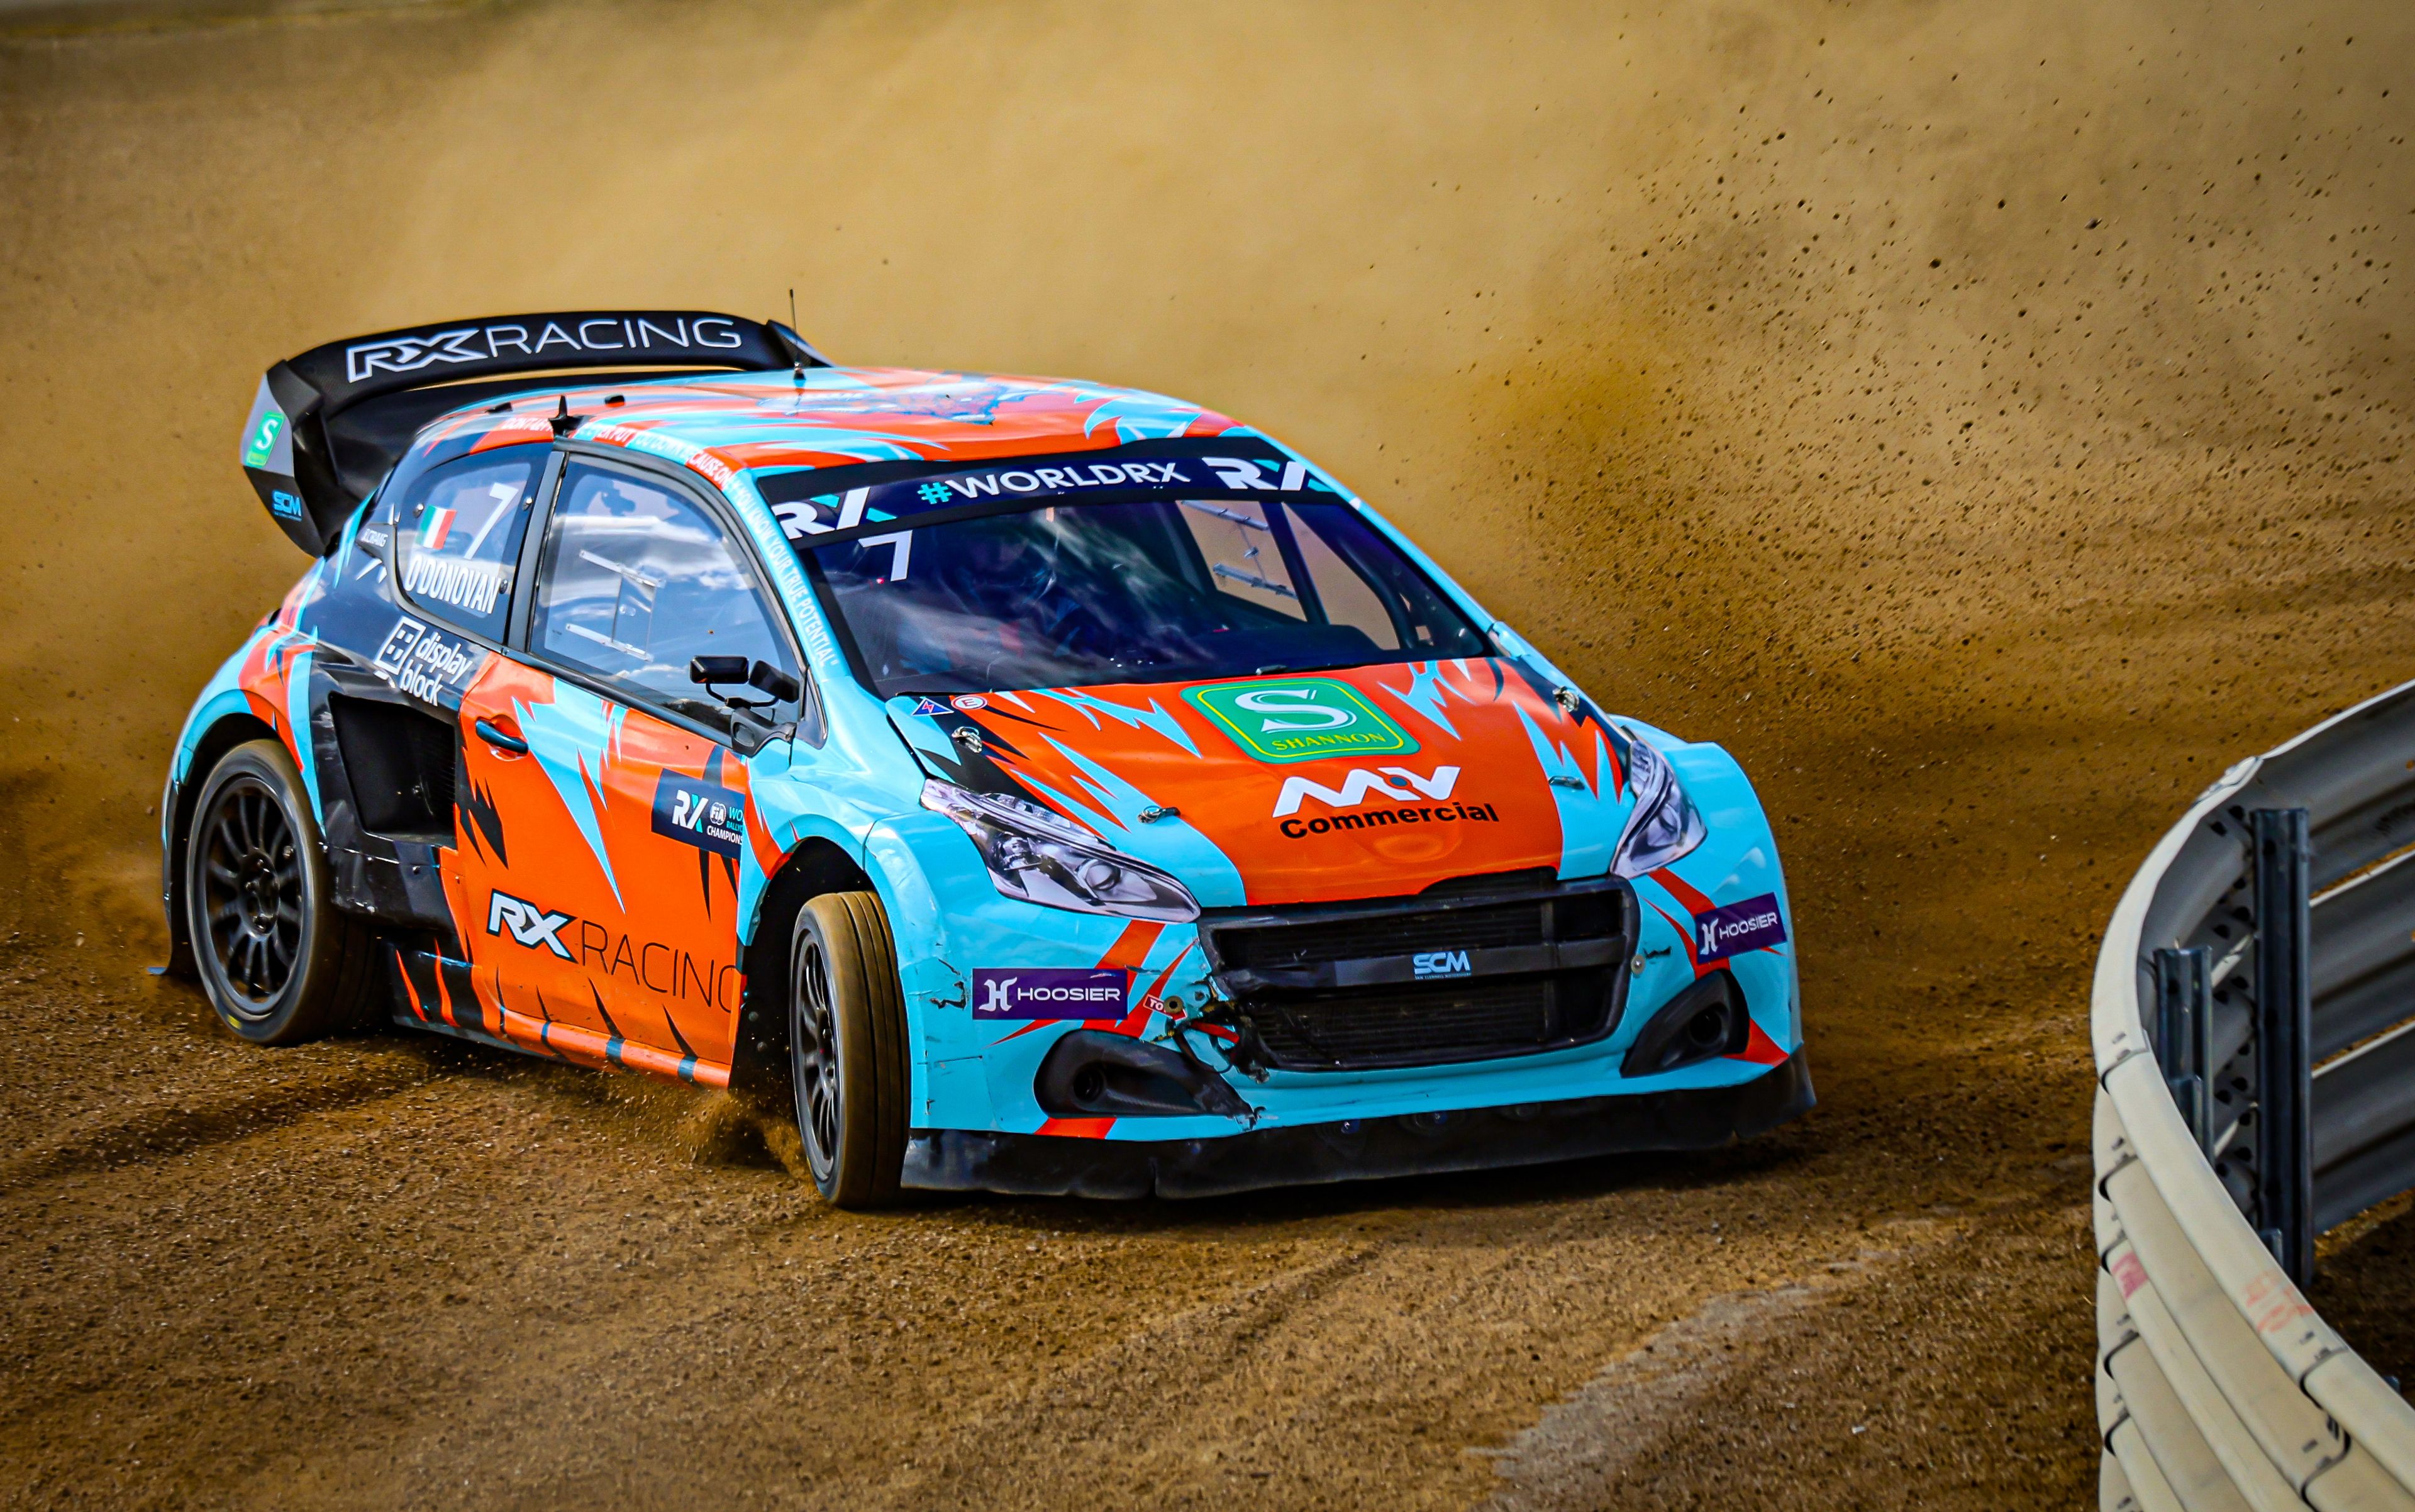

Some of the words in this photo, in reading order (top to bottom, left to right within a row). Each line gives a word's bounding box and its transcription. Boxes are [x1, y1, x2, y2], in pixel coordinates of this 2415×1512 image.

[347, 328, 489, 383] RX
[485, 317, 742, 359] RACING
[256, 418, 279, 450] S
[917, 462, 1191, 504] #WORLDRX
[463, 482, 519, 560] 7
[747, 507, 778, 543] KNOW
[766, 535, 795, 572] YOUR
[784, 567, 811, 600] TRUE
[858, 529, 913, 582] 7
[403, 553, 501, 614] O'DONOVAN
[414, 631, 474, 685] display
[399, 659, 443, 707] block
[962, 699, 977, 707] E
[1235, 688, 1357, 734] S
[1271, 733, 1386, 750] SHANNON
[672, 789, 709, 833] RX
[1279, 802, 1500, 839] Commercial
[487, 889, 578, 964] RX
[1719, 911, 1778, 940] HOOSIER
[1413, 950, 1470, 974] SCM
[1017, 987, 1121, 1001] HOOSIER
[1150, 998, 1166, 1013] TO
